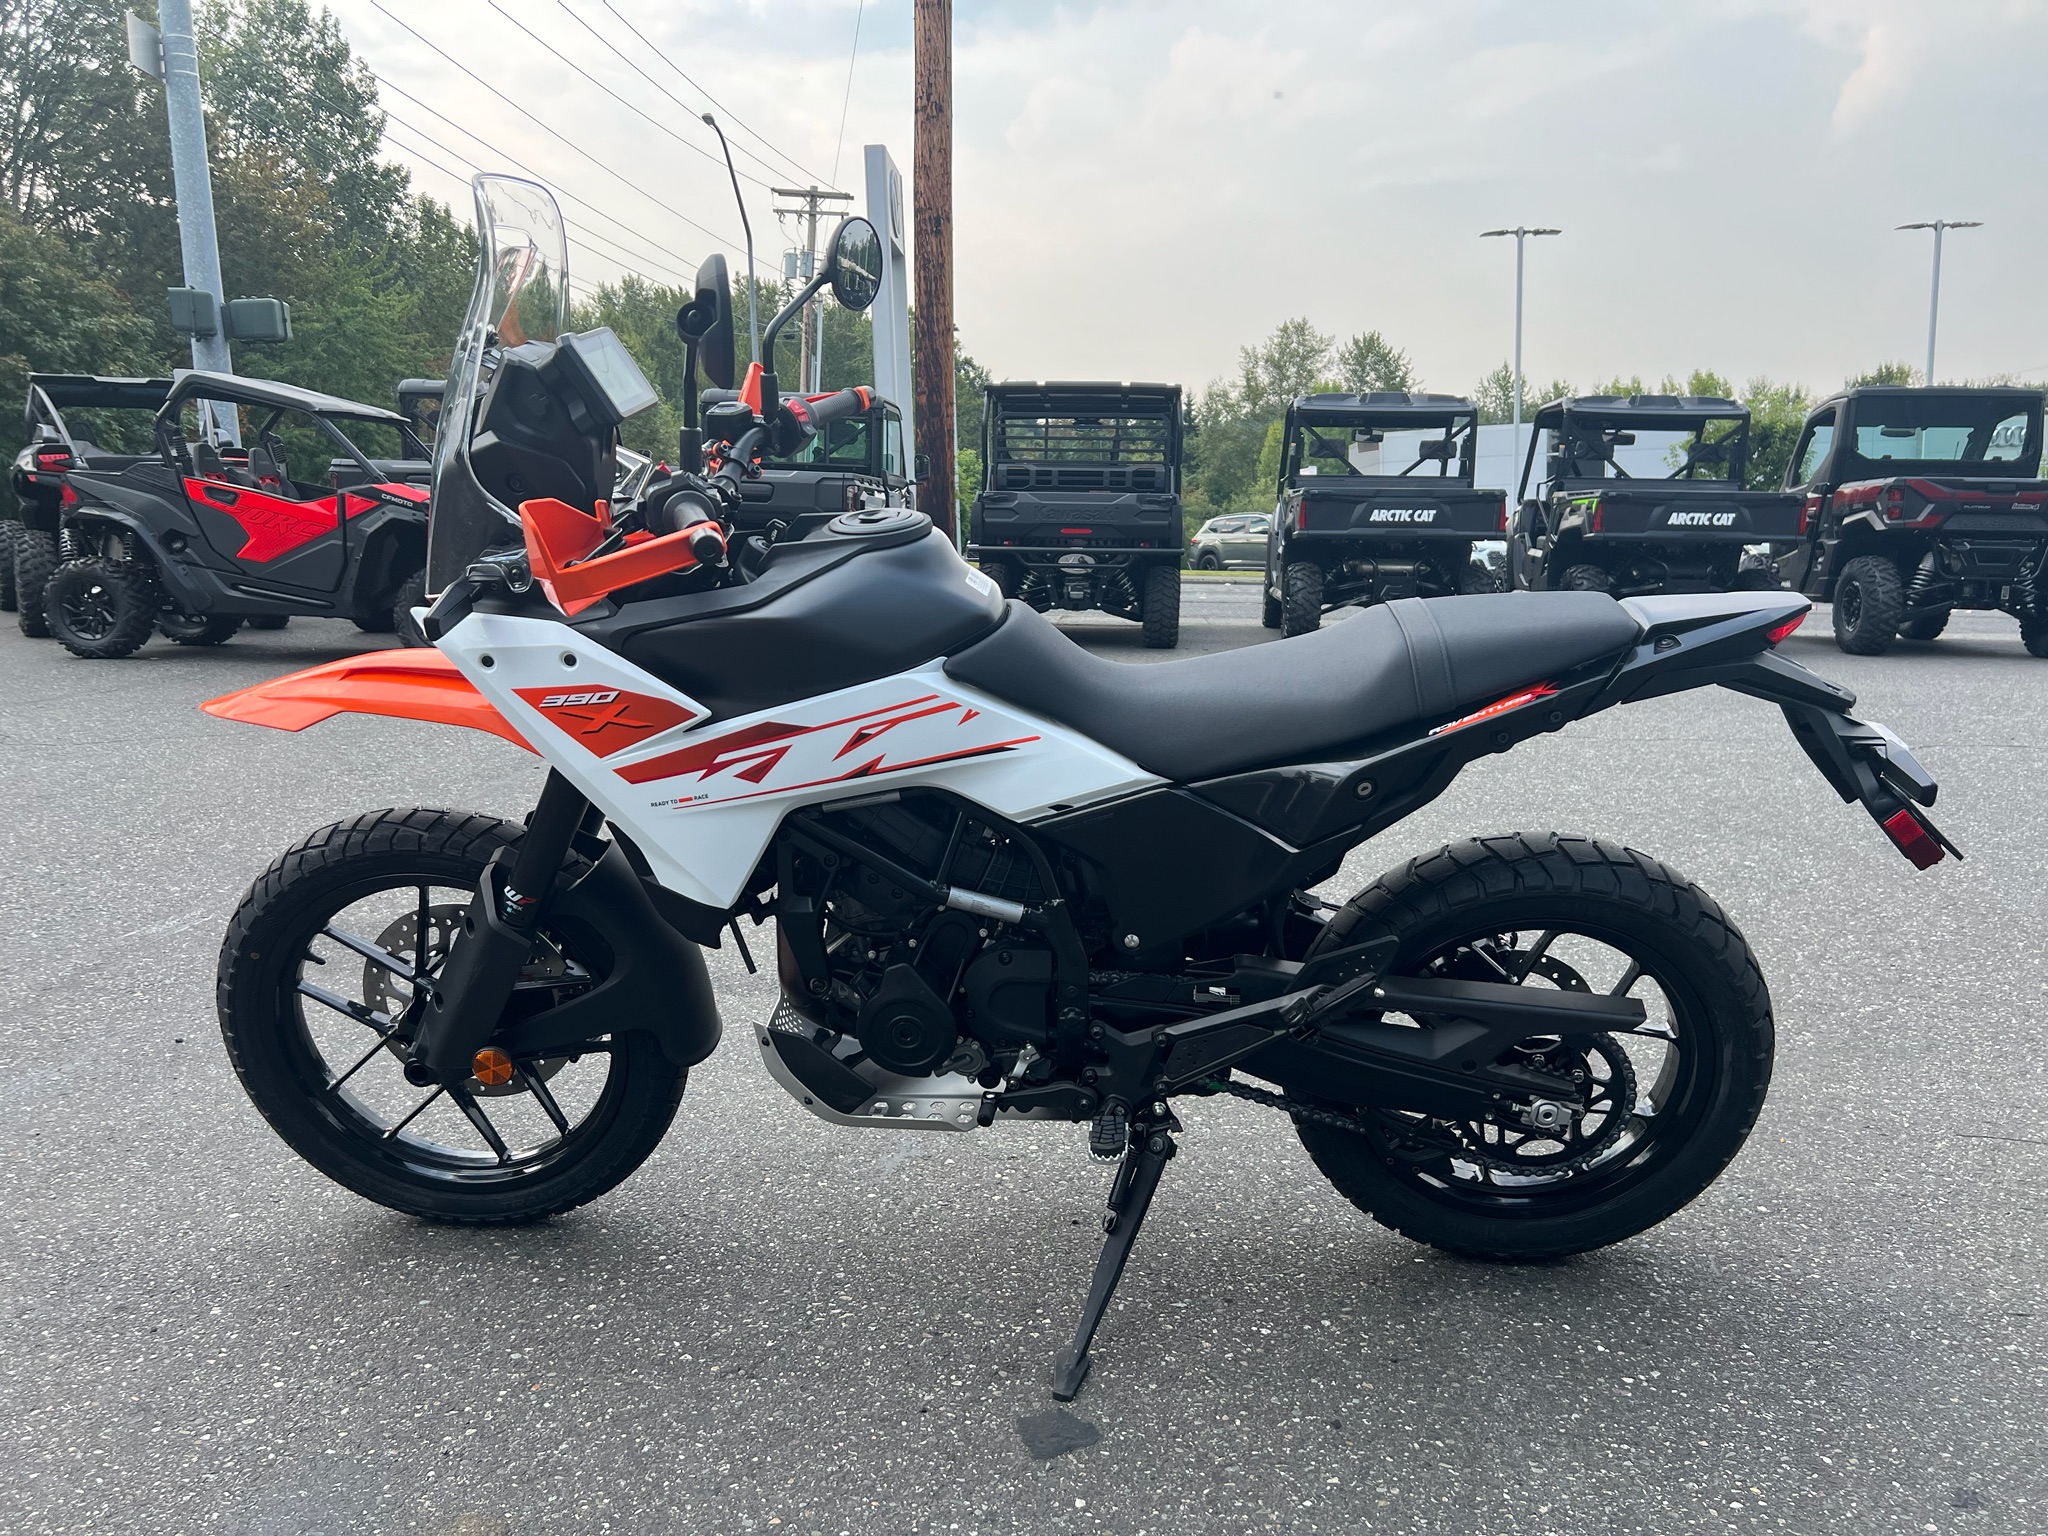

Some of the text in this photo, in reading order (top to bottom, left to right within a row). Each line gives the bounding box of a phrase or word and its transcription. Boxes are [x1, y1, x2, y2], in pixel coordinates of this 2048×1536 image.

[381, 493, 413, 507] CFMOTO
[1033, 504, 1119, 522] Kawasaki
[1369, 509, 1436, 522] ARCTIC CAT
[1667, 512, 1736, 526] ARCTIC CAT
[538, 690, 620, 708] 390
[1428, 693, 1532, 736] ADVENTURE
[650, 800, 670, 808] READY
[693, 793, 709, 801] RACE
